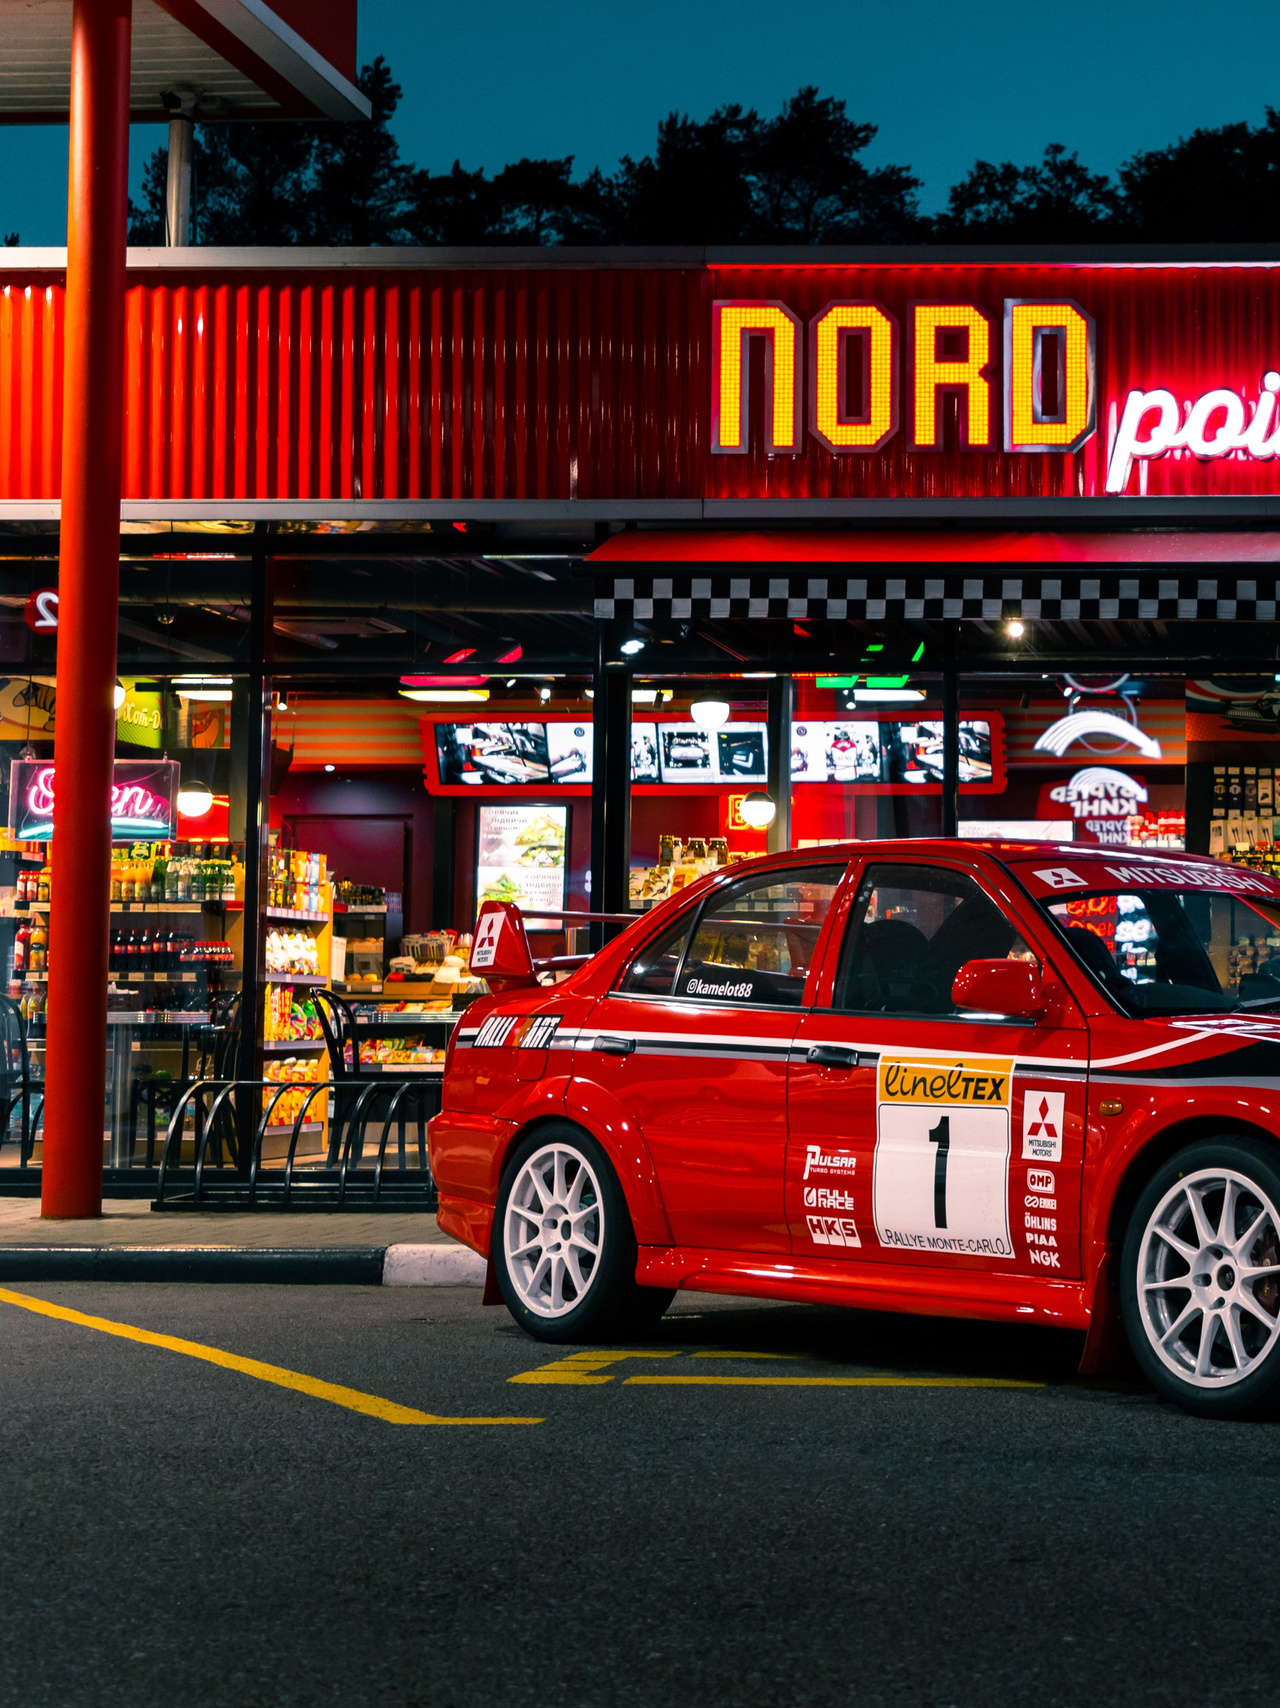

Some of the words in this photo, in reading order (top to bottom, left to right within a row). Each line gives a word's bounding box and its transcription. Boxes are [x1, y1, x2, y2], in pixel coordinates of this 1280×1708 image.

[1104, 866, 1275, 893] MITSUBISHI
[1028, 1139, 1057, 1149] MITSUBISHI
[1032, 1149, 1052, 1157] MOTORS
[803, 1145, 857, 1180] PULSAR
[810, 1166, 828, 1174] TURBO
[829, 1168, 856, 1176] SYSTEMS
[928, 1115, 950, 1229] 1
[1029, 1173, 1052, 1188] OMP
[818, 1188, 854, 1200] FULL
[818, 1198, 854, 1210] RACE
[807, 1216, 859, 1241] HKS
[1024, 1212, 1057, 1231] ÖHLINS
[885, 1229, 926, 1248] RALLYE
[926, 1236, 1005, 1255] MONTE-CARLO
[1026, 1232, 1058, 1247] PIAA
[1029, 1249, 1061, 1268] NGK
